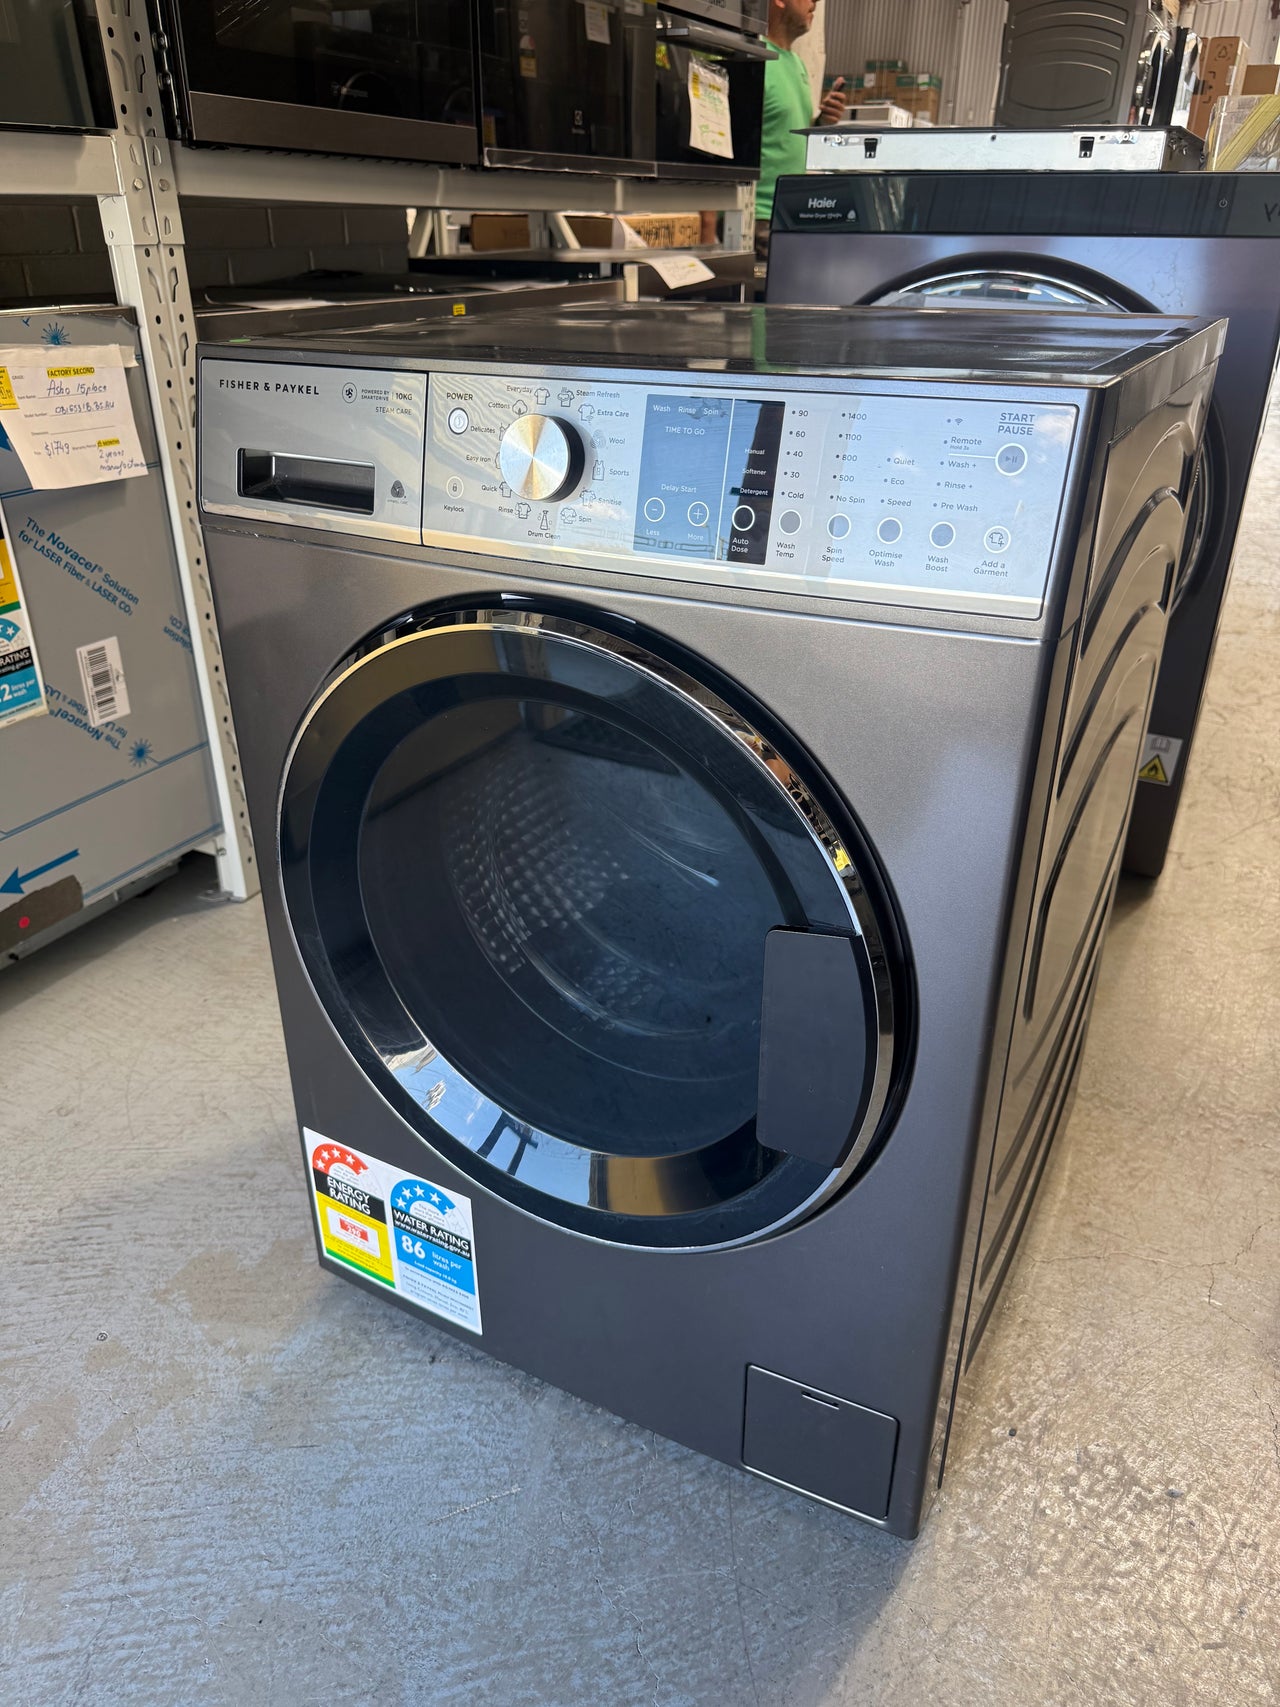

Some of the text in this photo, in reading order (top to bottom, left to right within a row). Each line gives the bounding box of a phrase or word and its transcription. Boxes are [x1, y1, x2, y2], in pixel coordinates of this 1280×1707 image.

[808, 198, 837, 208] Haier
[47, 367, 95, 377] FACTORY SECOND
[219, 379, 319, 395] FISHER & PAYKEL
[506, 385, 532, 394] Everyday
[447, 393, 473, 401] POWER
[613, 410, 629, 418] Care
[653, 404, 719, 416] Wash Rinse Spin
[848, 412, 867, 421] 1400
[1000, 412, 1035, 422] START
[470, 426, 496, 434] Delicates
[998, 425, 1033, 436] PAUSE
[609, 437, 626, 445] Wool
[845, 433, 862, 441] 1100
[950, 437, 982, 445] Remote
[793, 450, 803, 458] 40
[466, 455, 479, 463] Easy
[893, 457, 915, 466] Quiet
[948, 460, 970, 469] Wash
[609, 469, 629, 477] Sports
[742, 468, 766, 476] Softener
[790, 471, 800, 479] 30
[839, 474, 854, 482] 500
[661, 484, 697, 493] Delay Start
[944, 482, 966, 490] Rinse
[739, 487, 768, 497] Detergent
[598, 498, 622, 506] Sanitise
[836, 495, 865, 504] No Spin
[887, 498, 912, 507] Speed
[444, 505, 464, 513] Keylock
[498, 506, 513, 514] Rinse
[940, 502, 978, 512] Pre Wash
[579, 515, 592, 524] Spin
[528, 530, 561, 539] Drum Clean
[646, 529, 660, 537] Less
[732, 537, 749, 545] Auto
[731, 546, 748, 554] Dose
[776, 542, 795, 550] Wash
[826, 546, 842, 554] Spin
[776, 550, 794, 559] Temp
[869, 550, 903, 559] Optimise
[26, 516, 46, 538] The
[102, 573, 139, 605] Solution
[822, 555, 845, 564] Speed
[874, 559, 895, 568] Wash
[927, 555, 949, 564] Wash
[19, 530, 34, 544] for
[33, 541, 62, 566] LASER
[63, 561, 85, 581] Fiber
[92, 582, 118, 605] LASER
[925, 564, 948, 572] Boost
[981, 560, 998, 569] Add
[973, 568, 1008, 577] Garment
[0, 649, 29, 666] RATING
[105, 735, 121, 750] The
[327, 1176, 369, 1204] ENERGY
[330, 1188, 371, 1215] RATING
[393, 1209, 428, 1232] WATER
[430, 1226, 469, 1250] RATING
[402, 1235, 425, 1259] 86
[433, 1260, 449, 1271] wash
[451, 1261, 462, 1269] per
